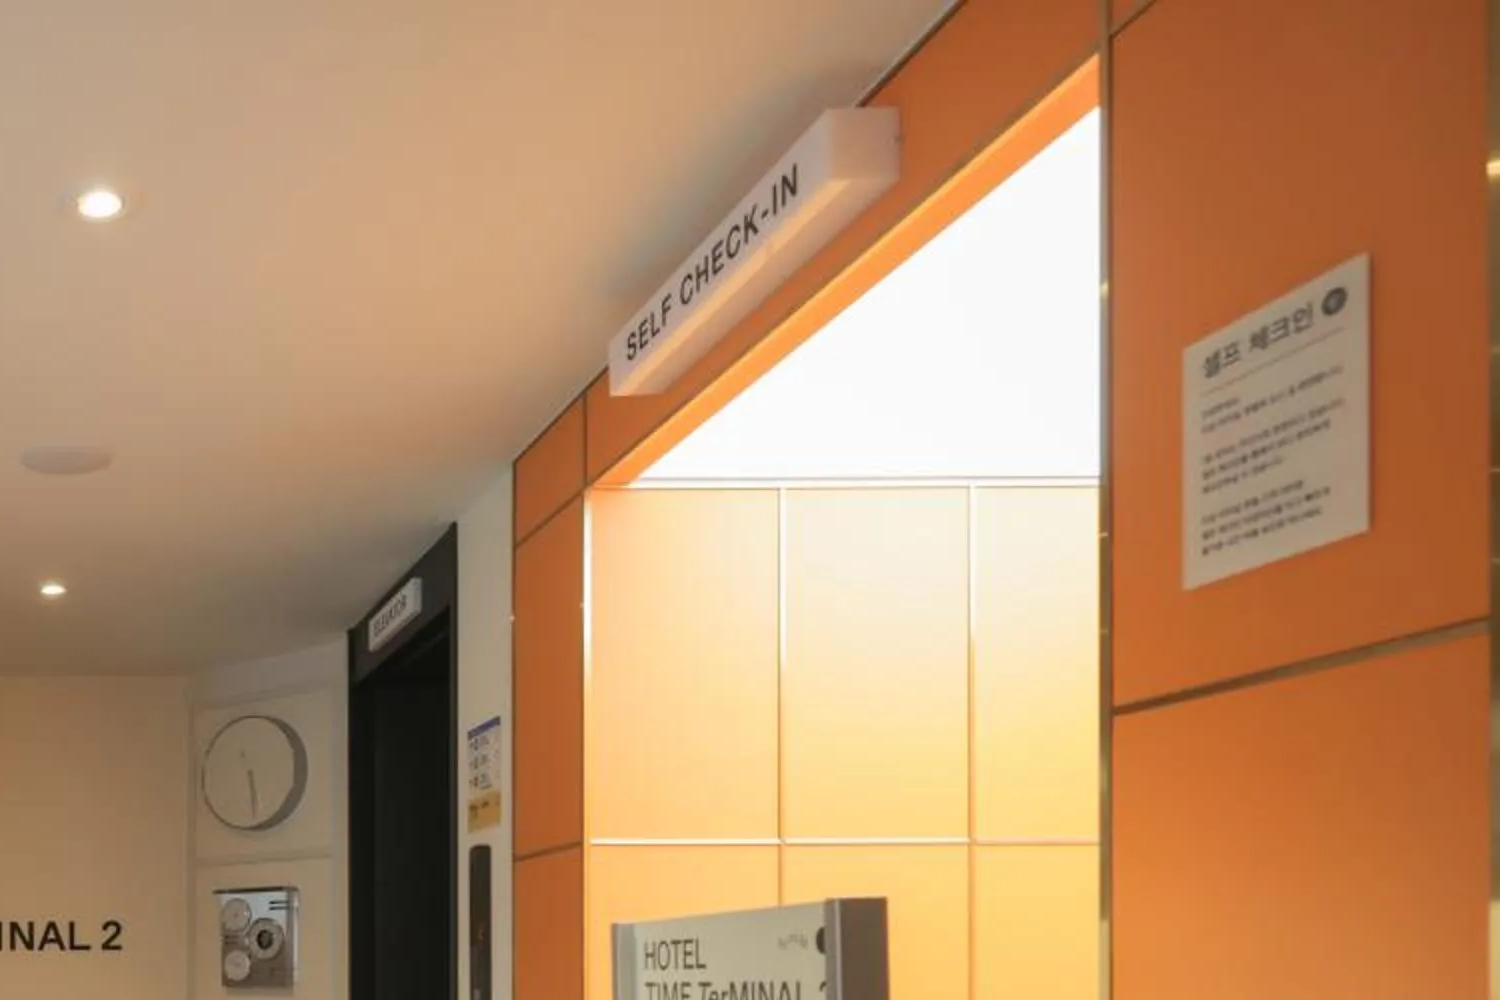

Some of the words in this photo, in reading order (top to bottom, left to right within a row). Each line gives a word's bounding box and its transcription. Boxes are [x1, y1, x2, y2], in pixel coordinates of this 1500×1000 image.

[626, 294, 672, 361] SELF
[679, 163, 798, 305] CHECK-IN
[101, 919, 123, 951] 2
[643, 938, 707, 971] HOTEL
